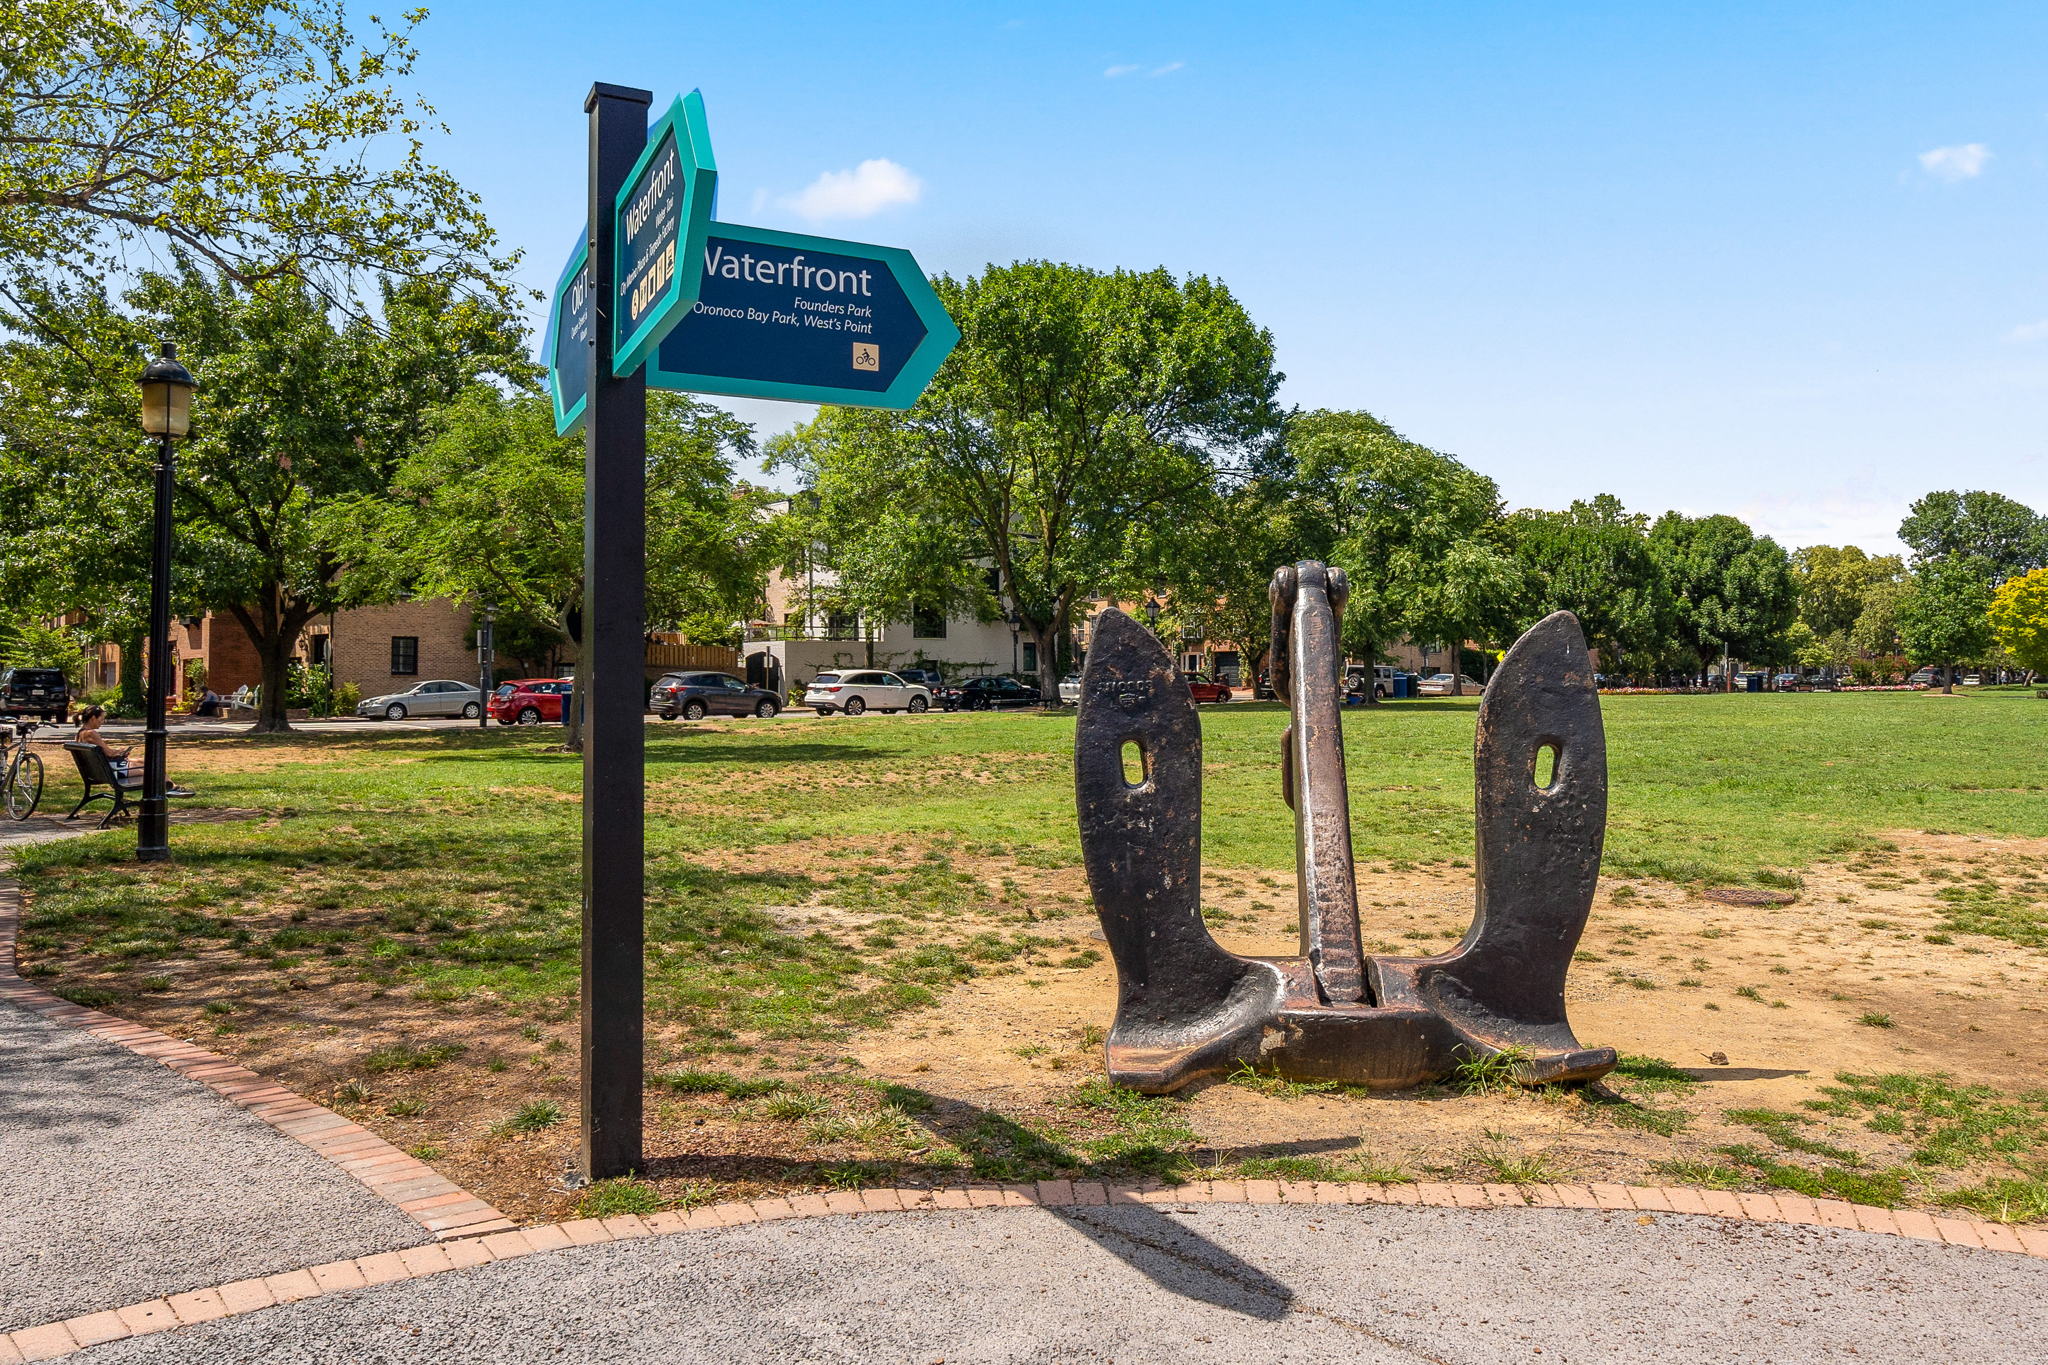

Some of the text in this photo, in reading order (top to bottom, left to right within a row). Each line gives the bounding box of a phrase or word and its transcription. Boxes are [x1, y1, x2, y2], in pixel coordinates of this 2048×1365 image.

[626, 149, 675, 246] Waterfront
[571, 273, 583, 316] Old
[583, 267, 589, 298] T
[794, 297, 872, 318] Founders Park
[693, 301, 872, 335] Oronoco Bay Park, West's Point
